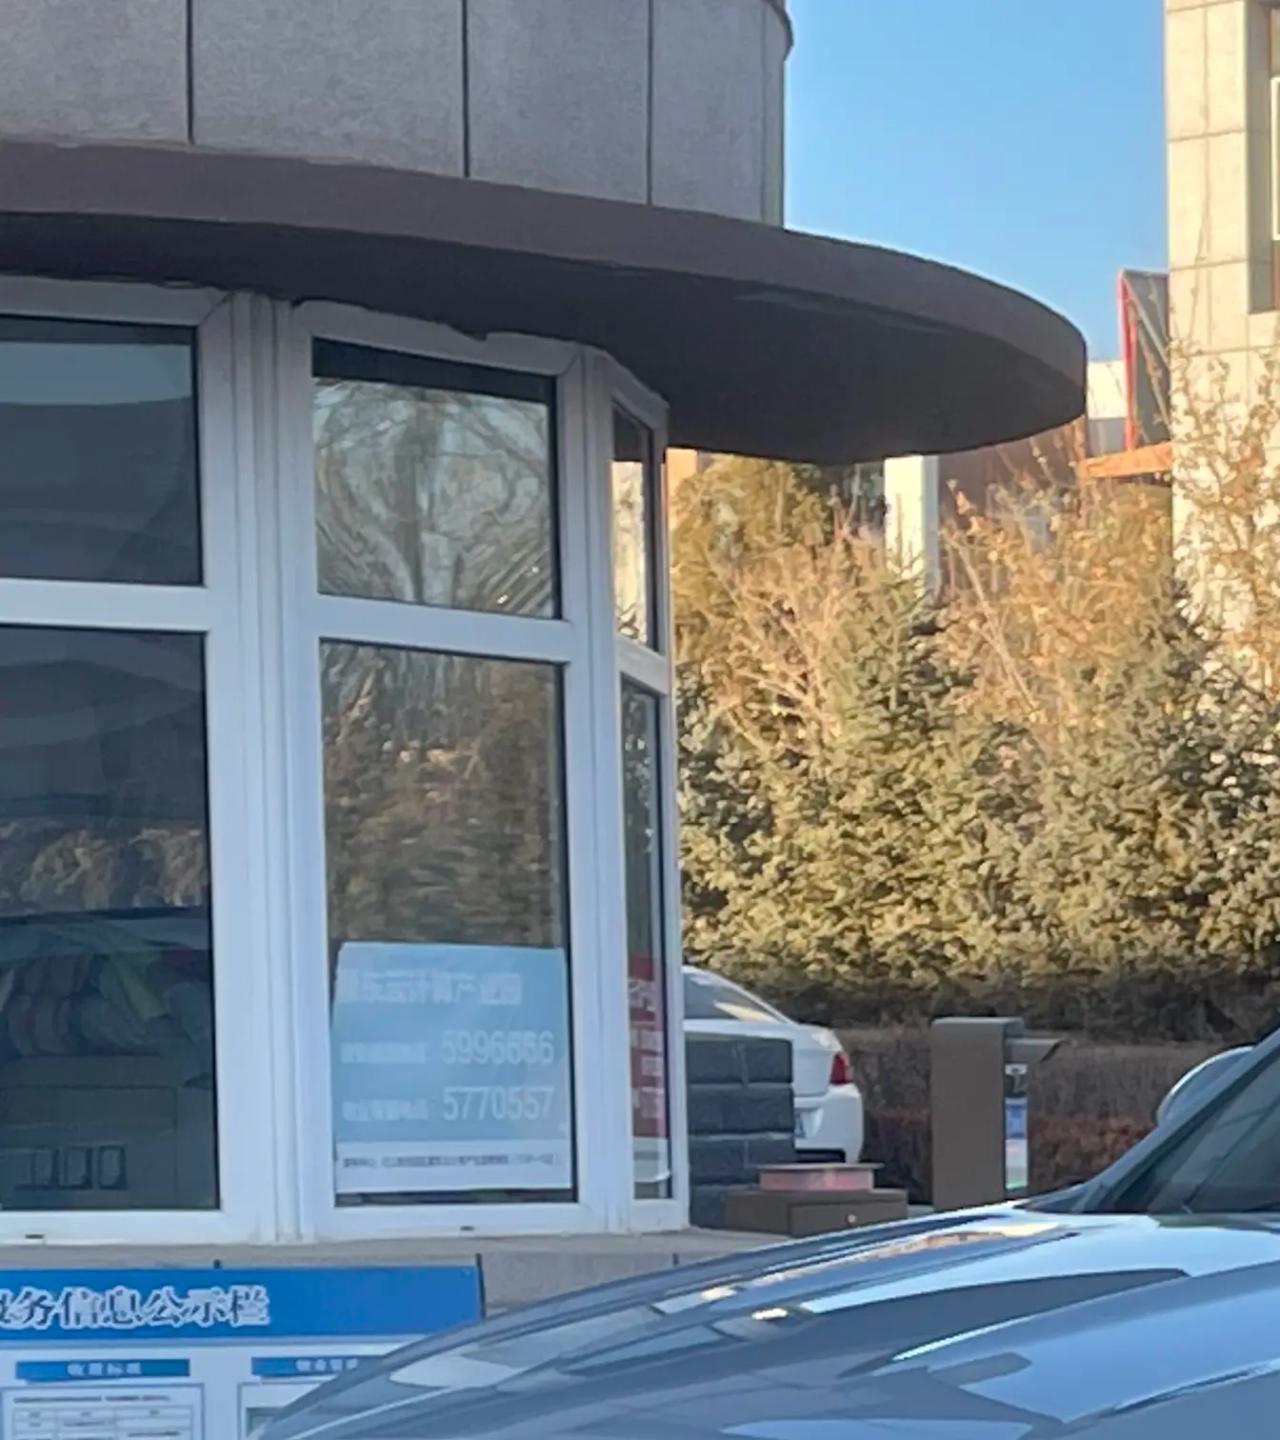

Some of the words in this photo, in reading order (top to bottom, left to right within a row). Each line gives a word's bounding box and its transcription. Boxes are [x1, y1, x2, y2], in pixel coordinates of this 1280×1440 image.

[443, 1086, 555, 1120] 5770557
[0, 1285, 270, 1329] 务信息公示栏
